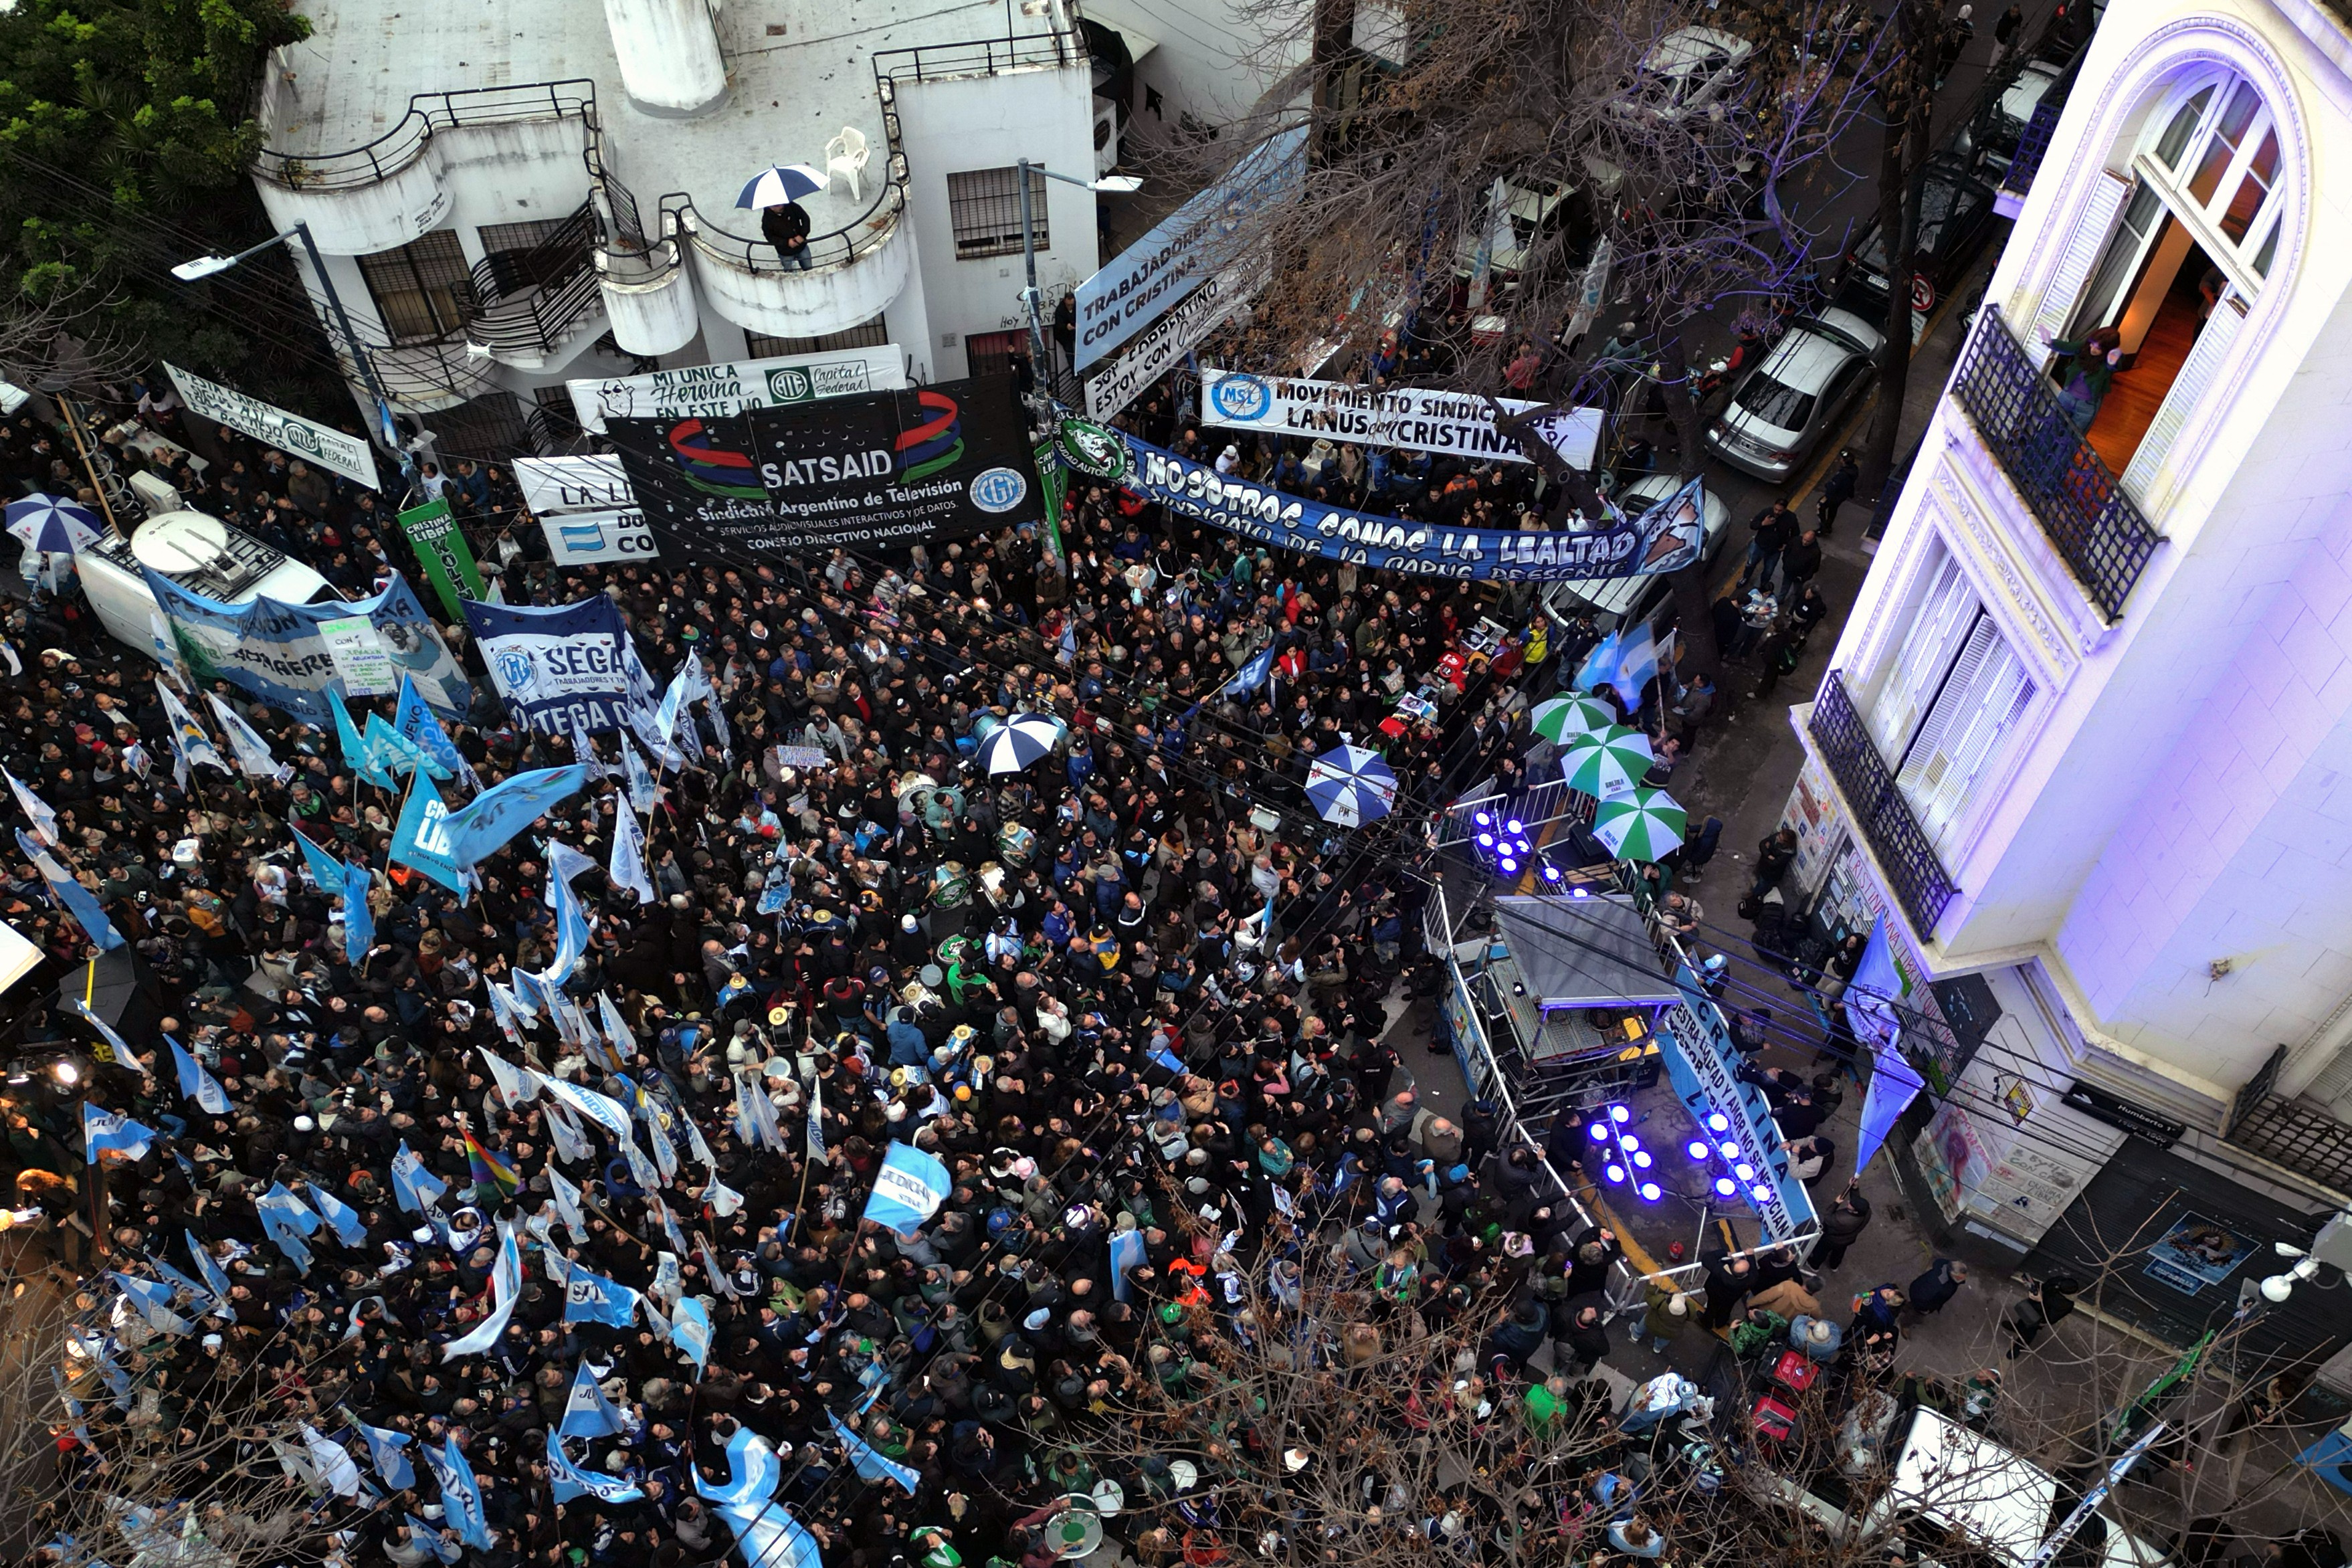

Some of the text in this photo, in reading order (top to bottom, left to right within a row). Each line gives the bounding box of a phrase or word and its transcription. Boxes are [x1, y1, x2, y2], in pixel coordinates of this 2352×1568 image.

[1083, 310, 1120, 347] CON
[1124, 255, 1197, 318] CRISTINA
[1000, 316, 1019, 328] HOY
[653, 363, 739, 387] MI UNICA
[813, 364, 864, 383] Capital
[1094, 362, 1119, 393] SOY
[1096, 366, 1137, 415] ESTOY
[1143, 338, 1171, 371] CON
[815, 379, 868, 395] Federal
[1276, 383, 1412, 413] MOVIMIENTO
[228, 390, 279, 417] CARCEL
[220, 413, 288, 450] POLITICO
[1288, 409, 1368, 435] LANÚS
[1397, 420, 1524, 456] CRISTINA
[324, 448, 360, 471] FEDERAL
[1038, 449, 1055, 464] CRIS
[1055, 440, 1078, 465] CIUDAD
[761, 450, 892, 488] SATSAID
[561, 481, 631, 505] LA LI
[780, 496, 858, 516] Argentino
[864, 492, 883, 506] de
[886, 479, 963, 502] Televisión
[979, 476, 1019, 504] CGT
[406, 514, 451, 534] CRISTINA
[617, 514, 646, 528] DO
[841, 508, 904, 526] INTERACTIVOS
[906, 509, 912, 518] Y
[914, 506, 926, 516] DE
[413, 522, 454, 543] LIBRE
[617, 534, 654, 554] CO
[747, 519, 937, 550] CONSEJO DIRECTIVO NACIONAL
[1442, 533, 1484, 561] LA
[1500, 531, 1637, 565] LEALTAD
[335, 636, 353, 646] CON
[554, 677, 609, 685] TRABAJADORES
[264, 695, 316, 716] PUEBLO
[403, 705, 423, 741] UEVO
[425, 799, 448, 819] CR
[413, 818, 450, 856] LIB
[1719, 1084, 1733, 1099] Y
[1725, 1097, 1749, 1135] AMOR
[2117, 1104, 2163, 1129] Humberto
[1739, 1130, 1758, 1154] NO
[1746, 1151, 1765, 1173] SE
[2010, 1157, 2038, 1173] CON
